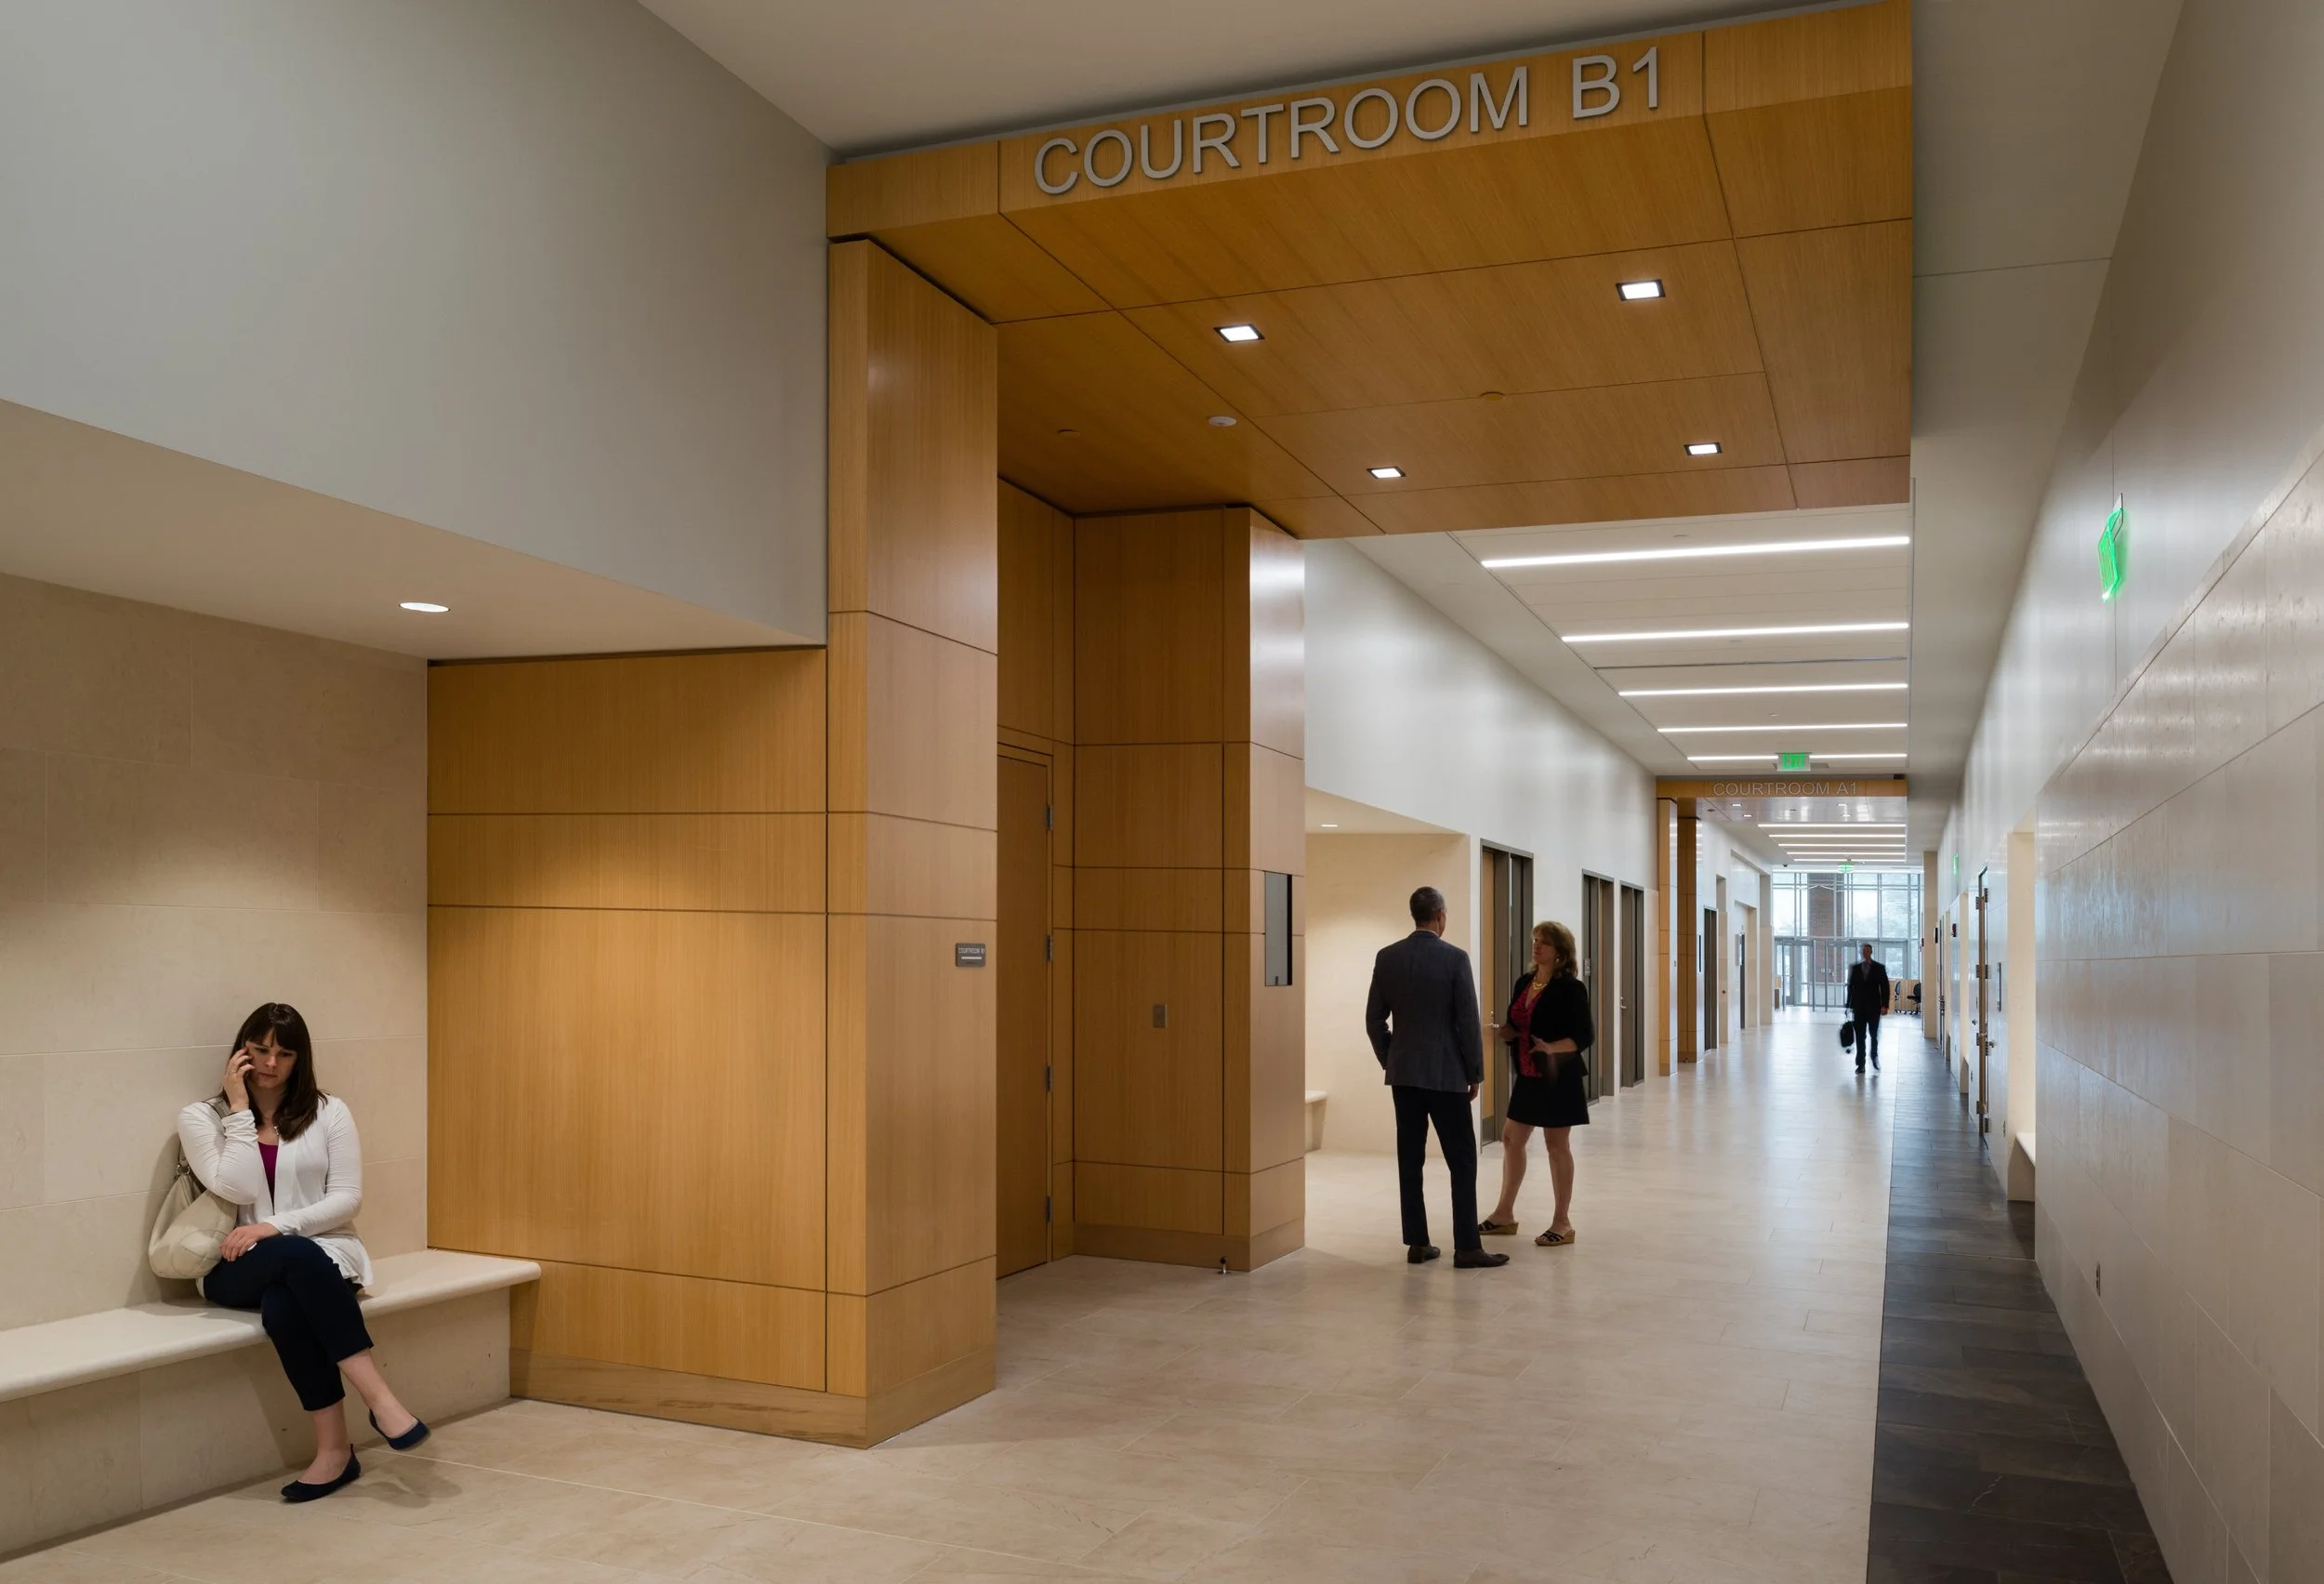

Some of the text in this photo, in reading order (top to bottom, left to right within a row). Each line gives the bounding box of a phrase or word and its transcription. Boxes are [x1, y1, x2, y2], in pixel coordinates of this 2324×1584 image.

[1033, 46, 1659, 194] COURTROOM B1
[1782, 754, 1805, 770] EXIT
[1713, 781, 1857, 796] COURTROOM A1
